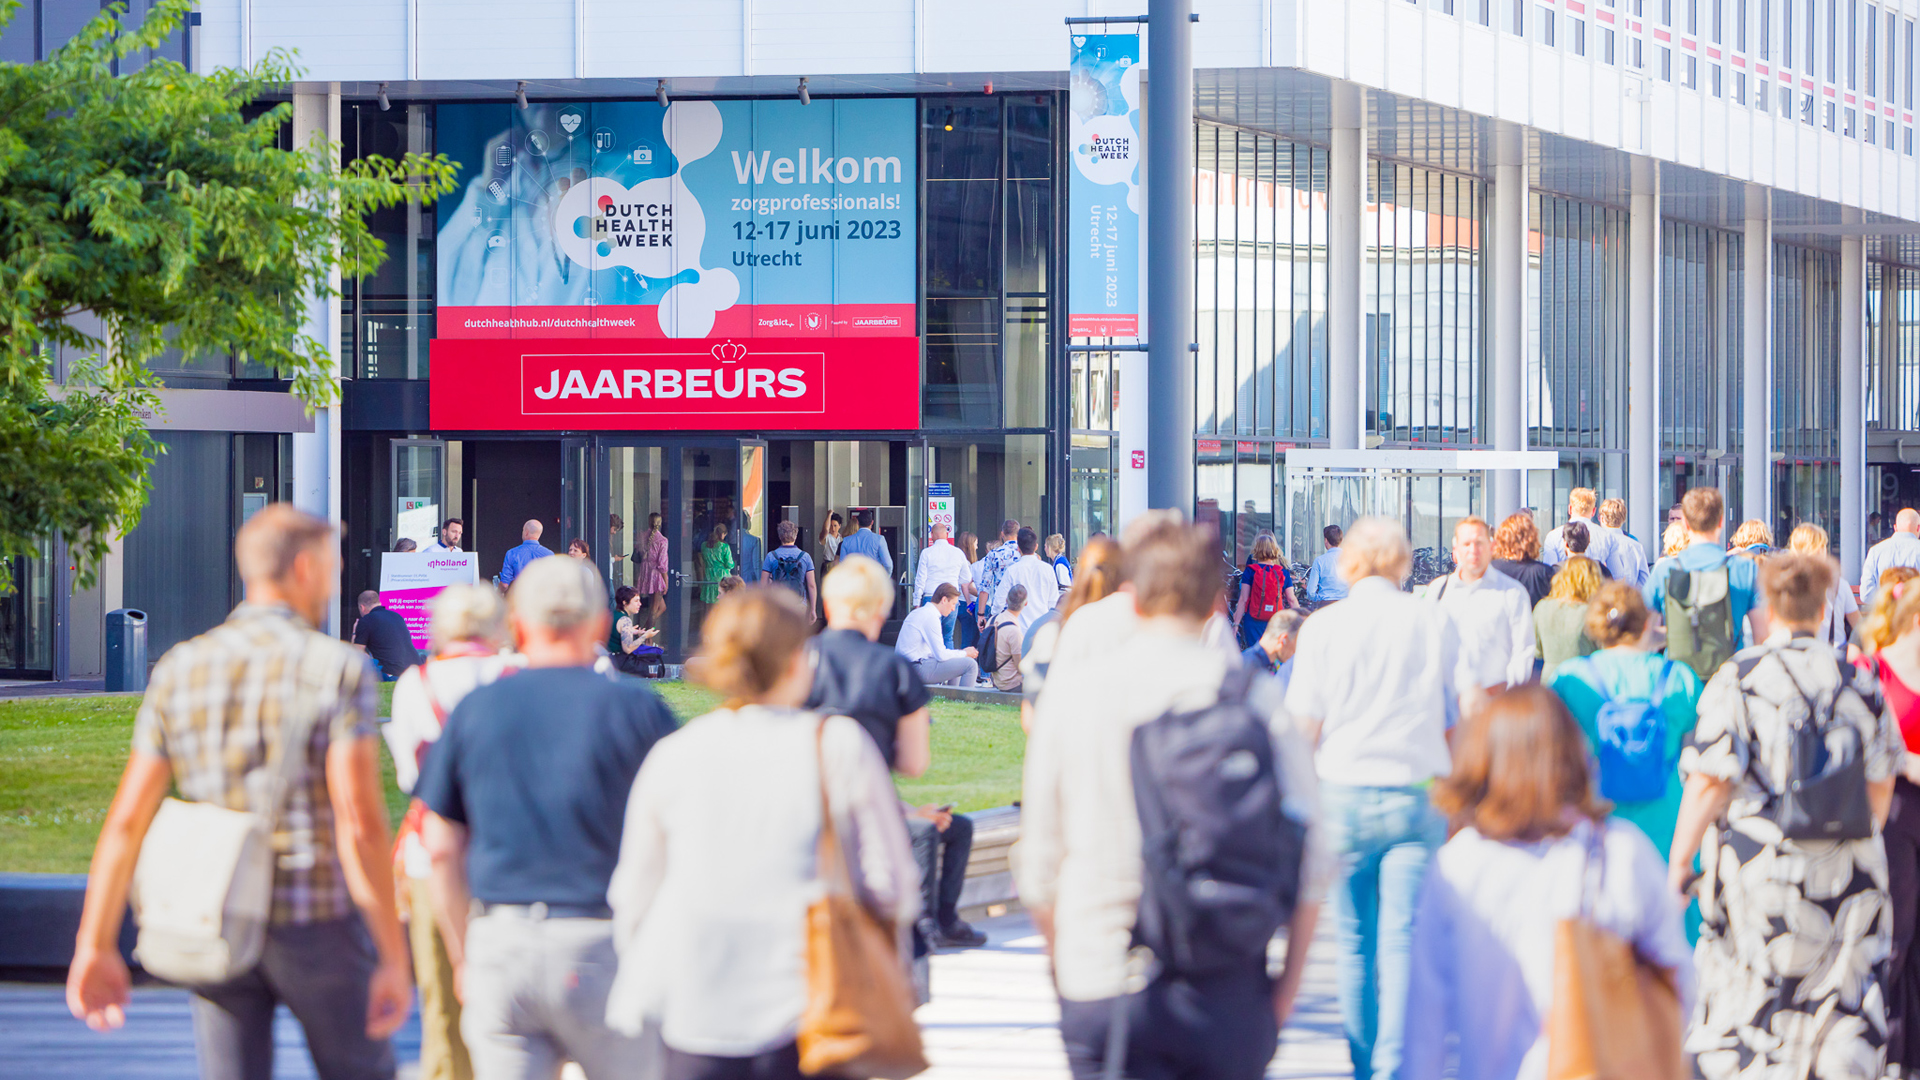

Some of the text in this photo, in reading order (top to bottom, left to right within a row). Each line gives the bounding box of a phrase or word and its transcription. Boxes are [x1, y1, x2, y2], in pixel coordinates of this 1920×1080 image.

[731, 148, 902, 184] Welkom
[605, 204, 672, 217] DUTCH
[731, 193, 901, 215] zorgprofessionals!
[596, 219, 672, 232] HEALTH
[732, 220, 902, 246] 12-17 juni 2023
[1090, 205, 1102, 259] Utrecht
[616, 234, 672, 247] WEEK
[732, 250, 802, 267] Utrecht
[1103, 205, 1118, 307] 12-17 juni 2023
[854, 318, 898, 326] JAARBEURS
[534, 367, 807, 400] JAARBEURS
